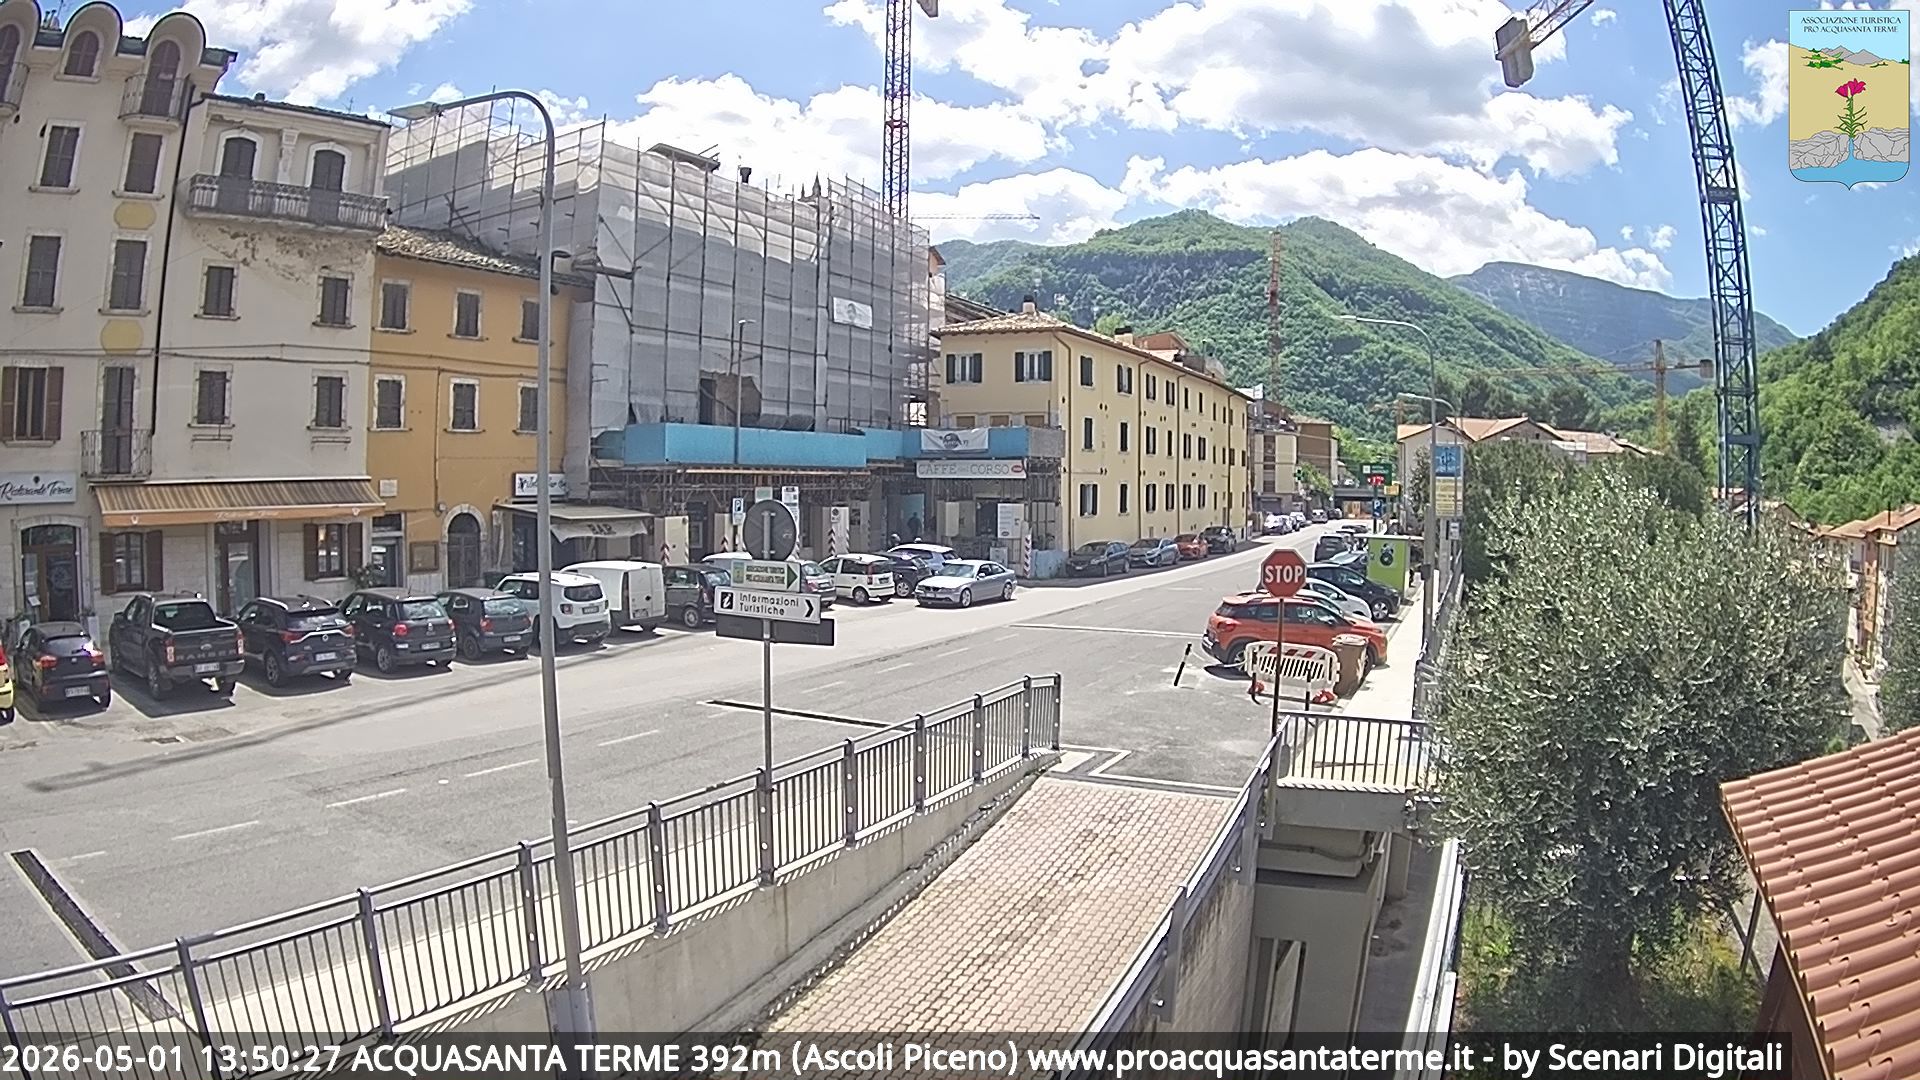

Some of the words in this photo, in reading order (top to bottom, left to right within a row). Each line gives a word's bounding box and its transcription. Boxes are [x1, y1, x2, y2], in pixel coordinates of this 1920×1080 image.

[970, 464, 1009, 475] CORSO
[1265, 565, 1304, 584] STOP
[740, 593, 800, 607] Informazioni
[740, 602, 785, 616] Turistiche
